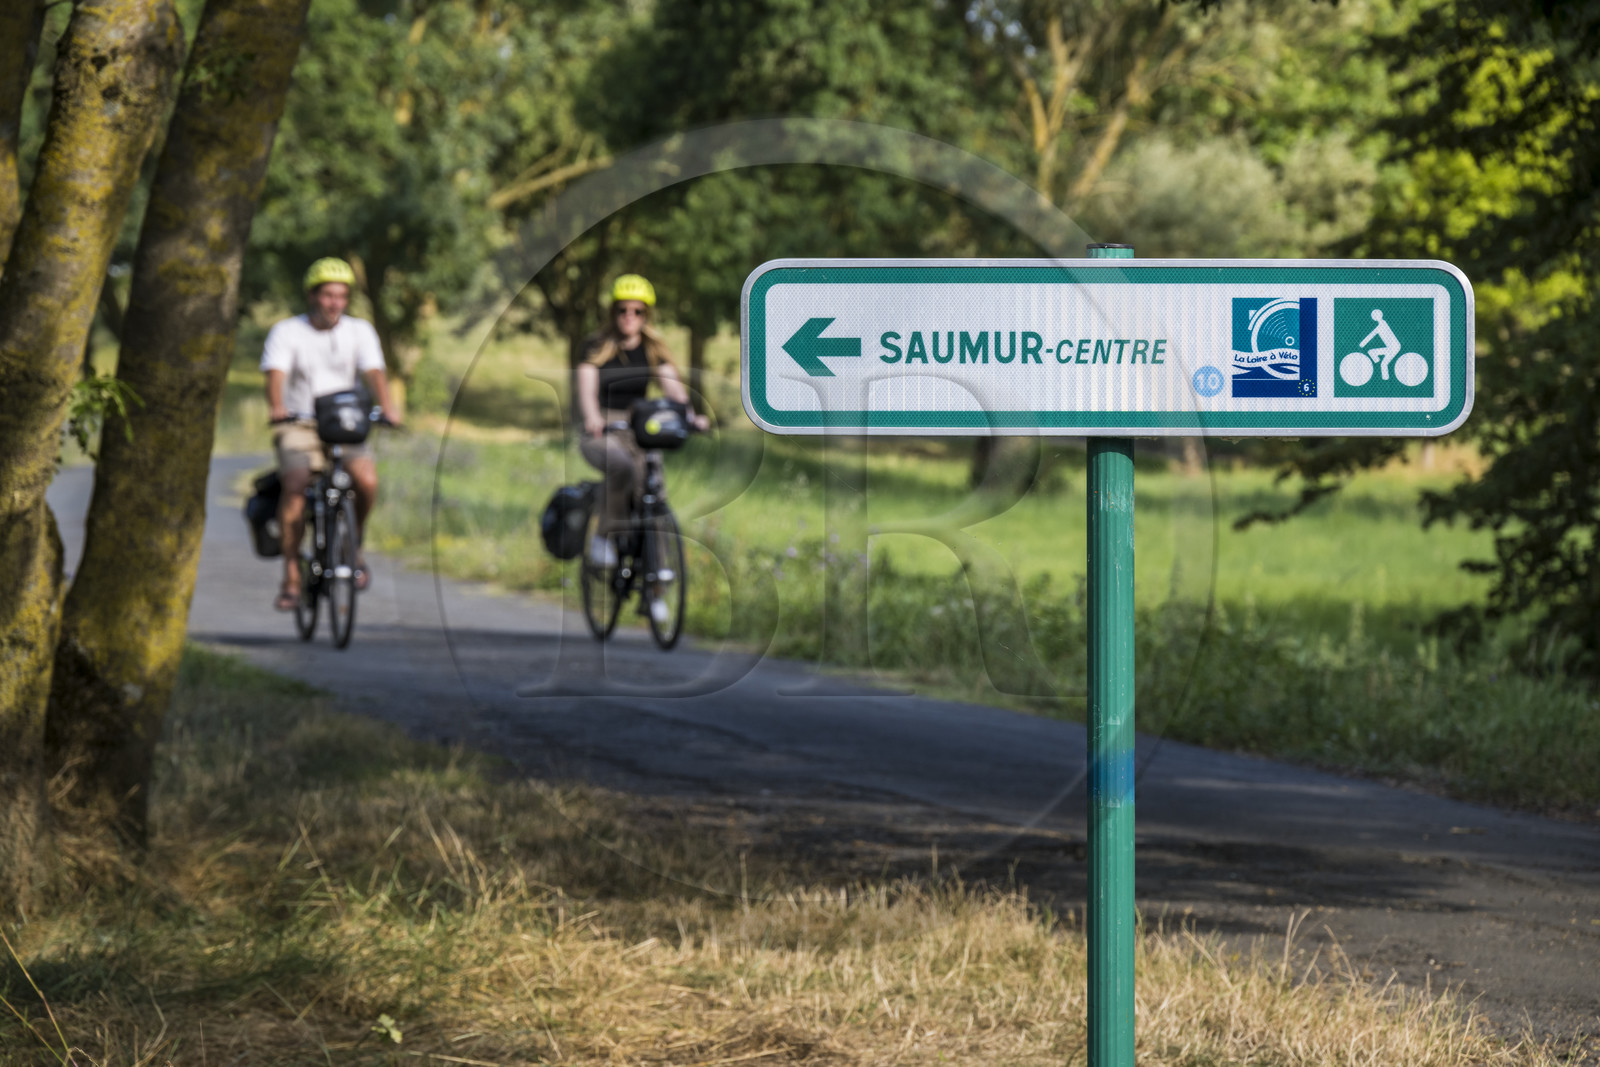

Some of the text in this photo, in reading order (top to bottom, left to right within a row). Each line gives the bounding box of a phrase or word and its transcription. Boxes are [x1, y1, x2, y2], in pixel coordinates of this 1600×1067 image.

[879, 331, 1167, 364] SAUMUR-CENTRE
[1234, 354, 1245, 362] La
[1270, 352, 1276, 360] à
[1278, 351, 1298, 360] Vélo
[1197, 373, 1218, 390] 10
[1303, 383, 1310, 392] 6
